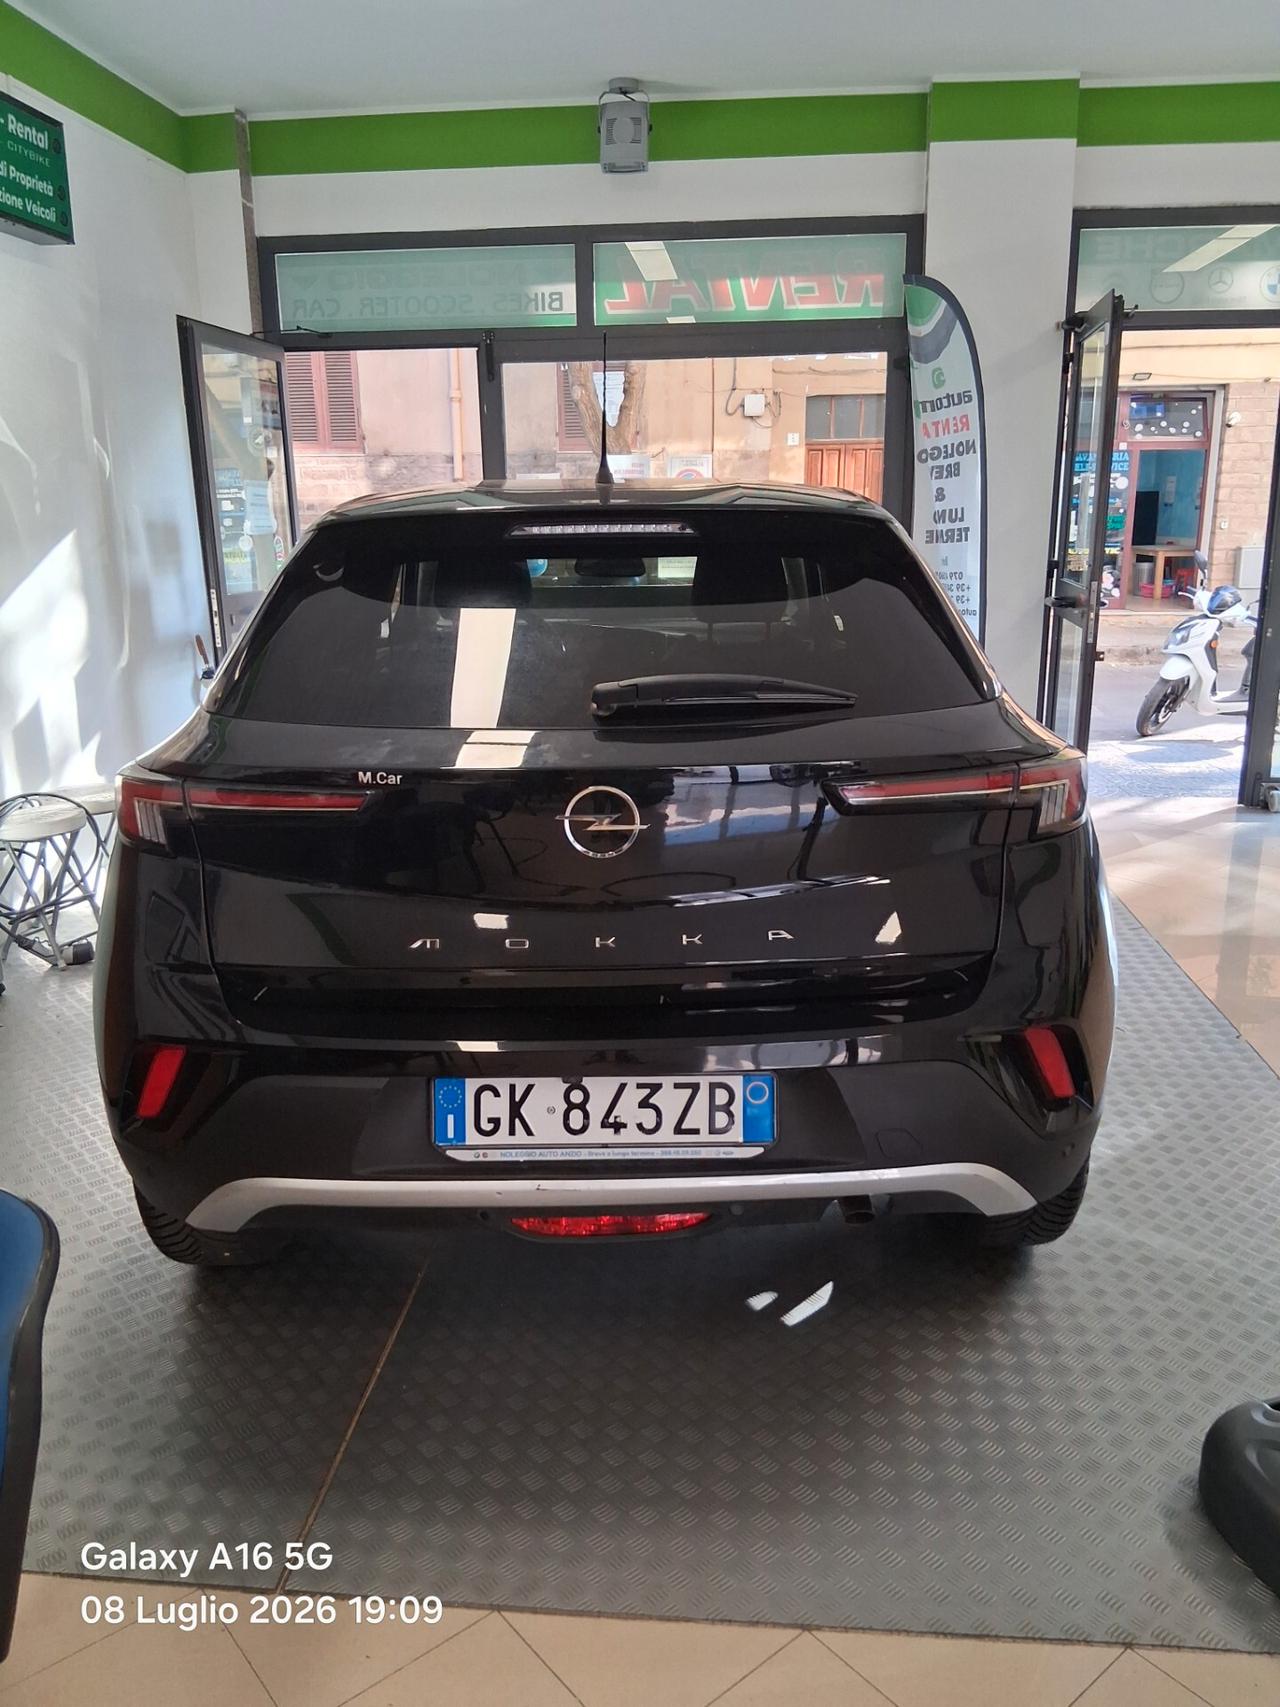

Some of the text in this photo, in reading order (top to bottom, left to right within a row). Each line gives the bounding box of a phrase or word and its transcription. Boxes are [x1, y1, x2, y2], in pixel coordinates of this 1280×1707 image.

[7, 113, 49, 150] Rental
[8, 140, 50, 168] CITYBIKE
[9, 165, 54, 197] Proprietà
[25, 197, 56, 223] Veicoli
[357, 771, 402, 785] M.Car
[410, 929, 794, 949] MOKKA
[473, 1083, 536, 1137] GK
[562, 1081, 737, 1136] 843ZB
